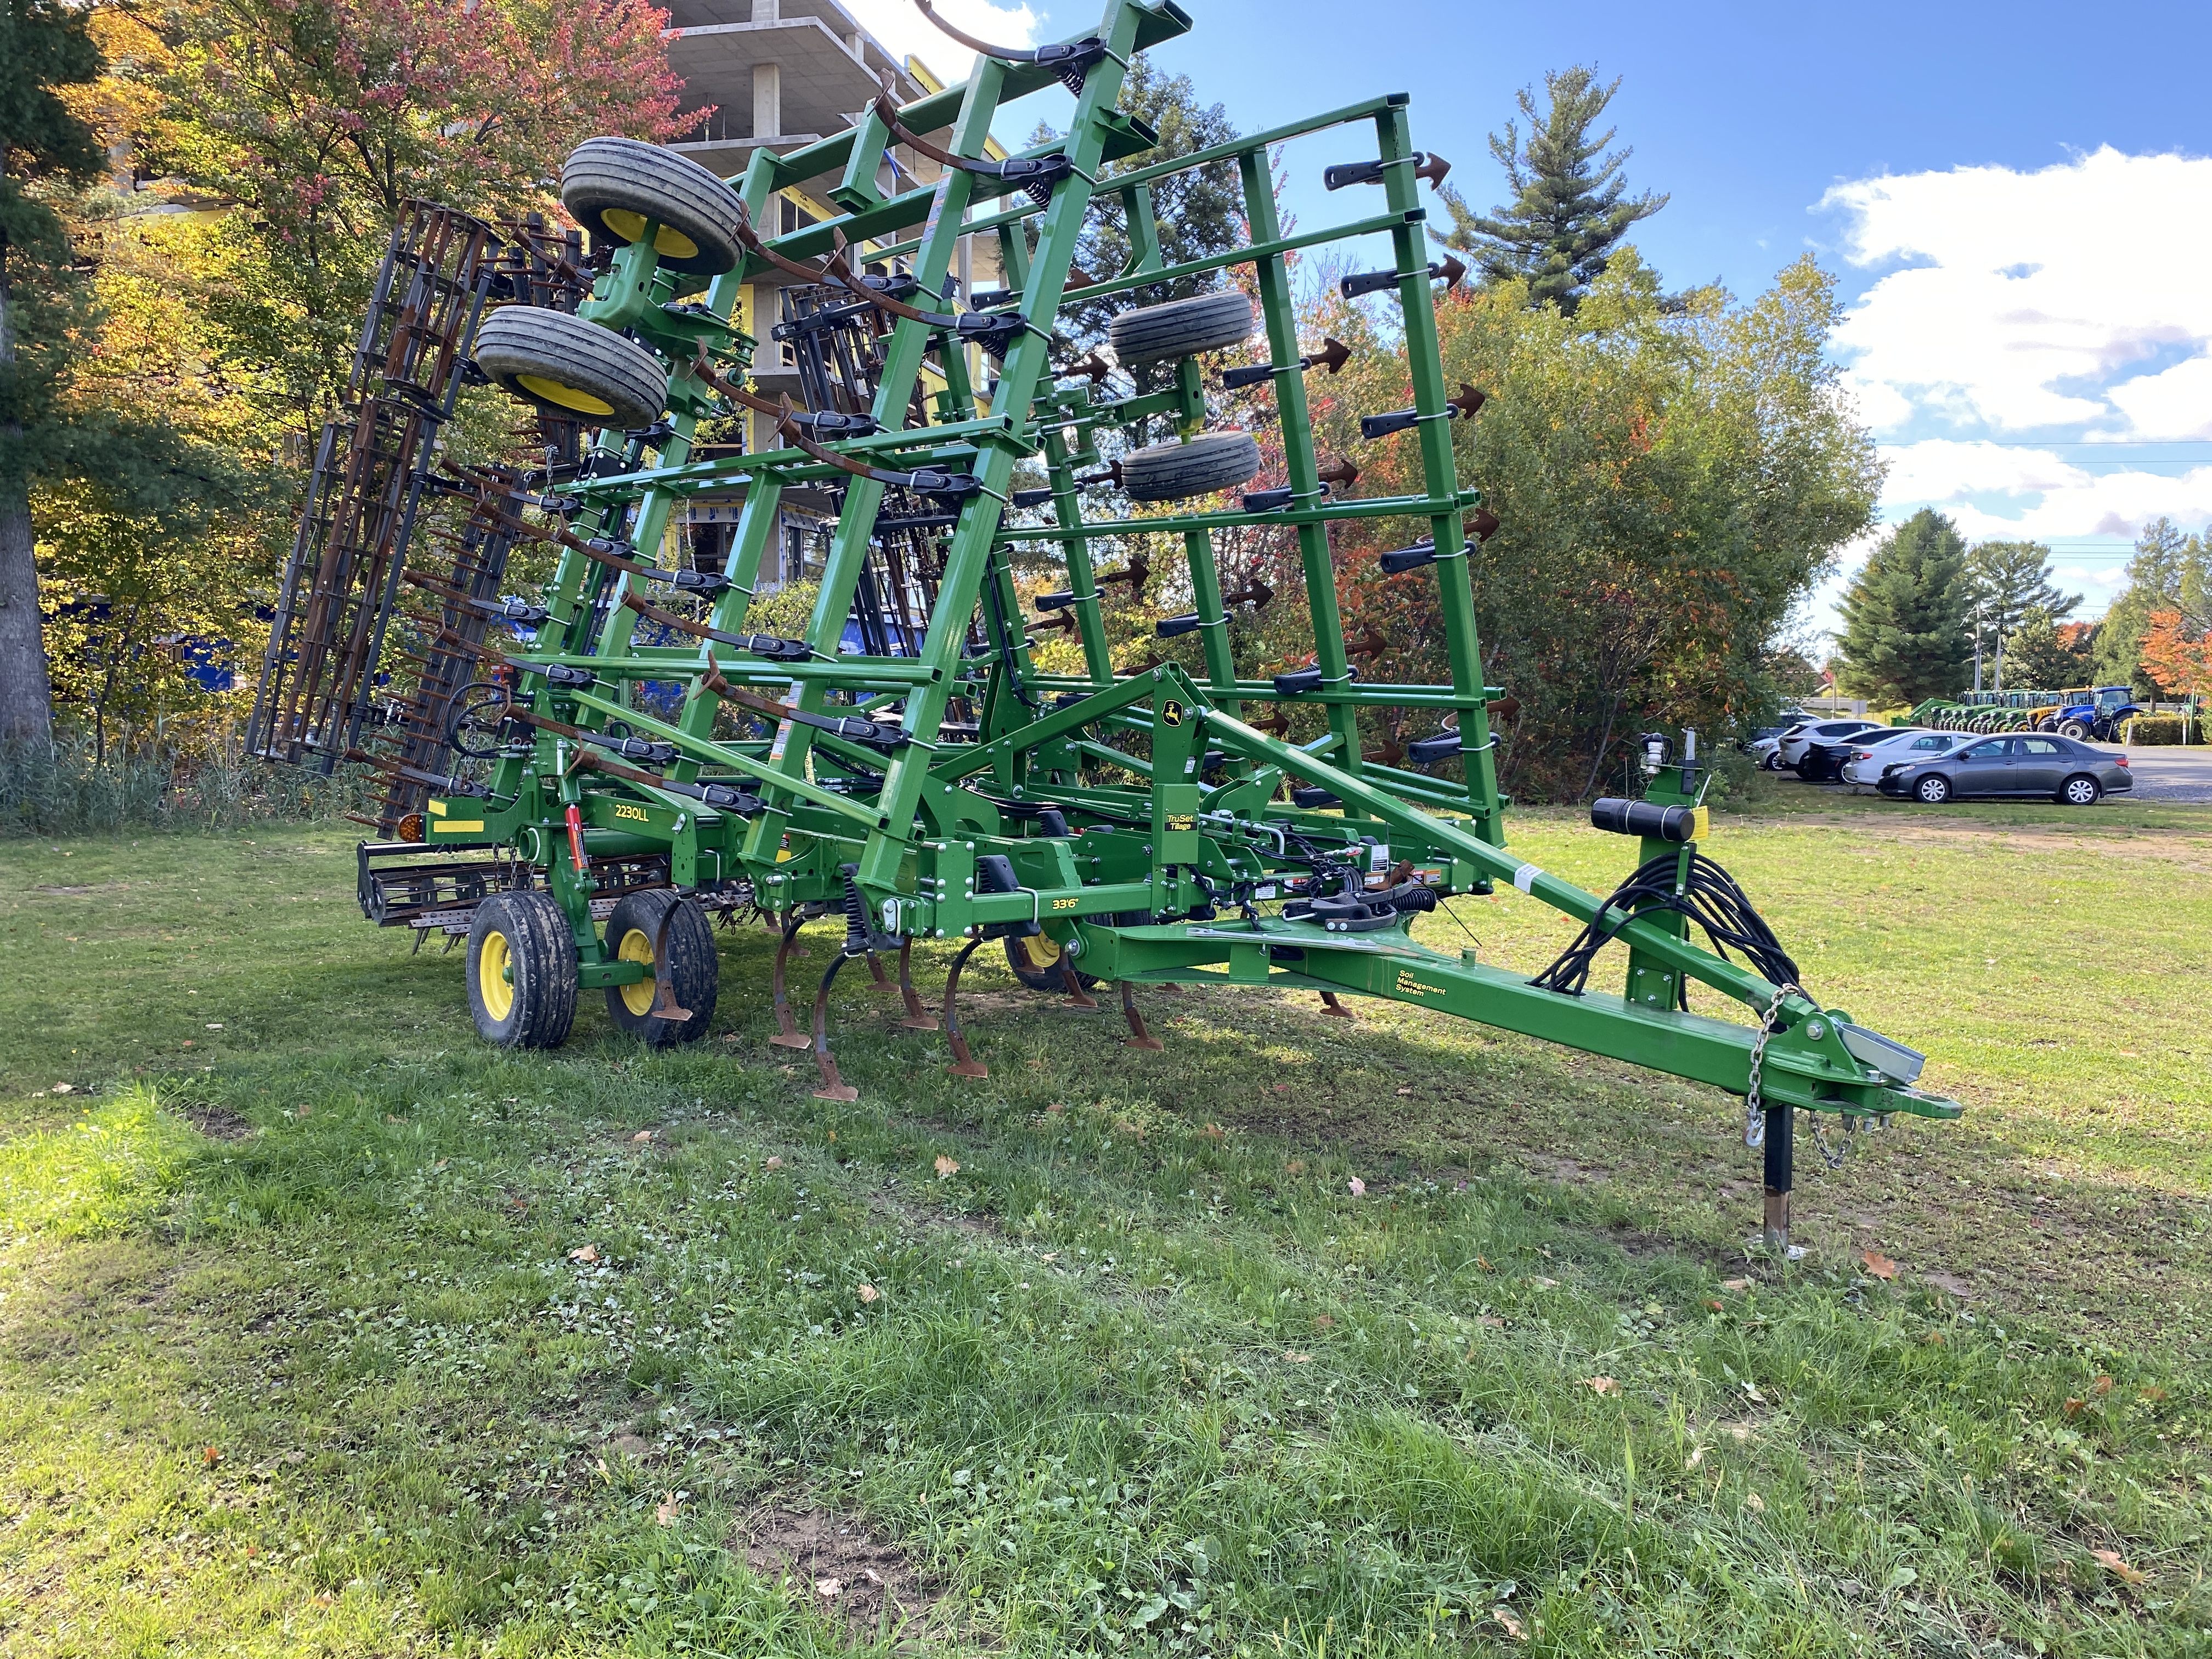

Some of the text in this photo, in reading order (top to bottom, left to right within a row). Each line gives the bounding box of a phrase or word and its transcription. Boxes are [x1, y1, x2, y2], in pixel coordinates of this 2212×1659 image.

[1167, 814, 1194, 822] TruSet
[1399, 969, 1414, 979] Soil
[1395, 984, 1424, 997] System
[1397, 977, 1447, 995] Management
